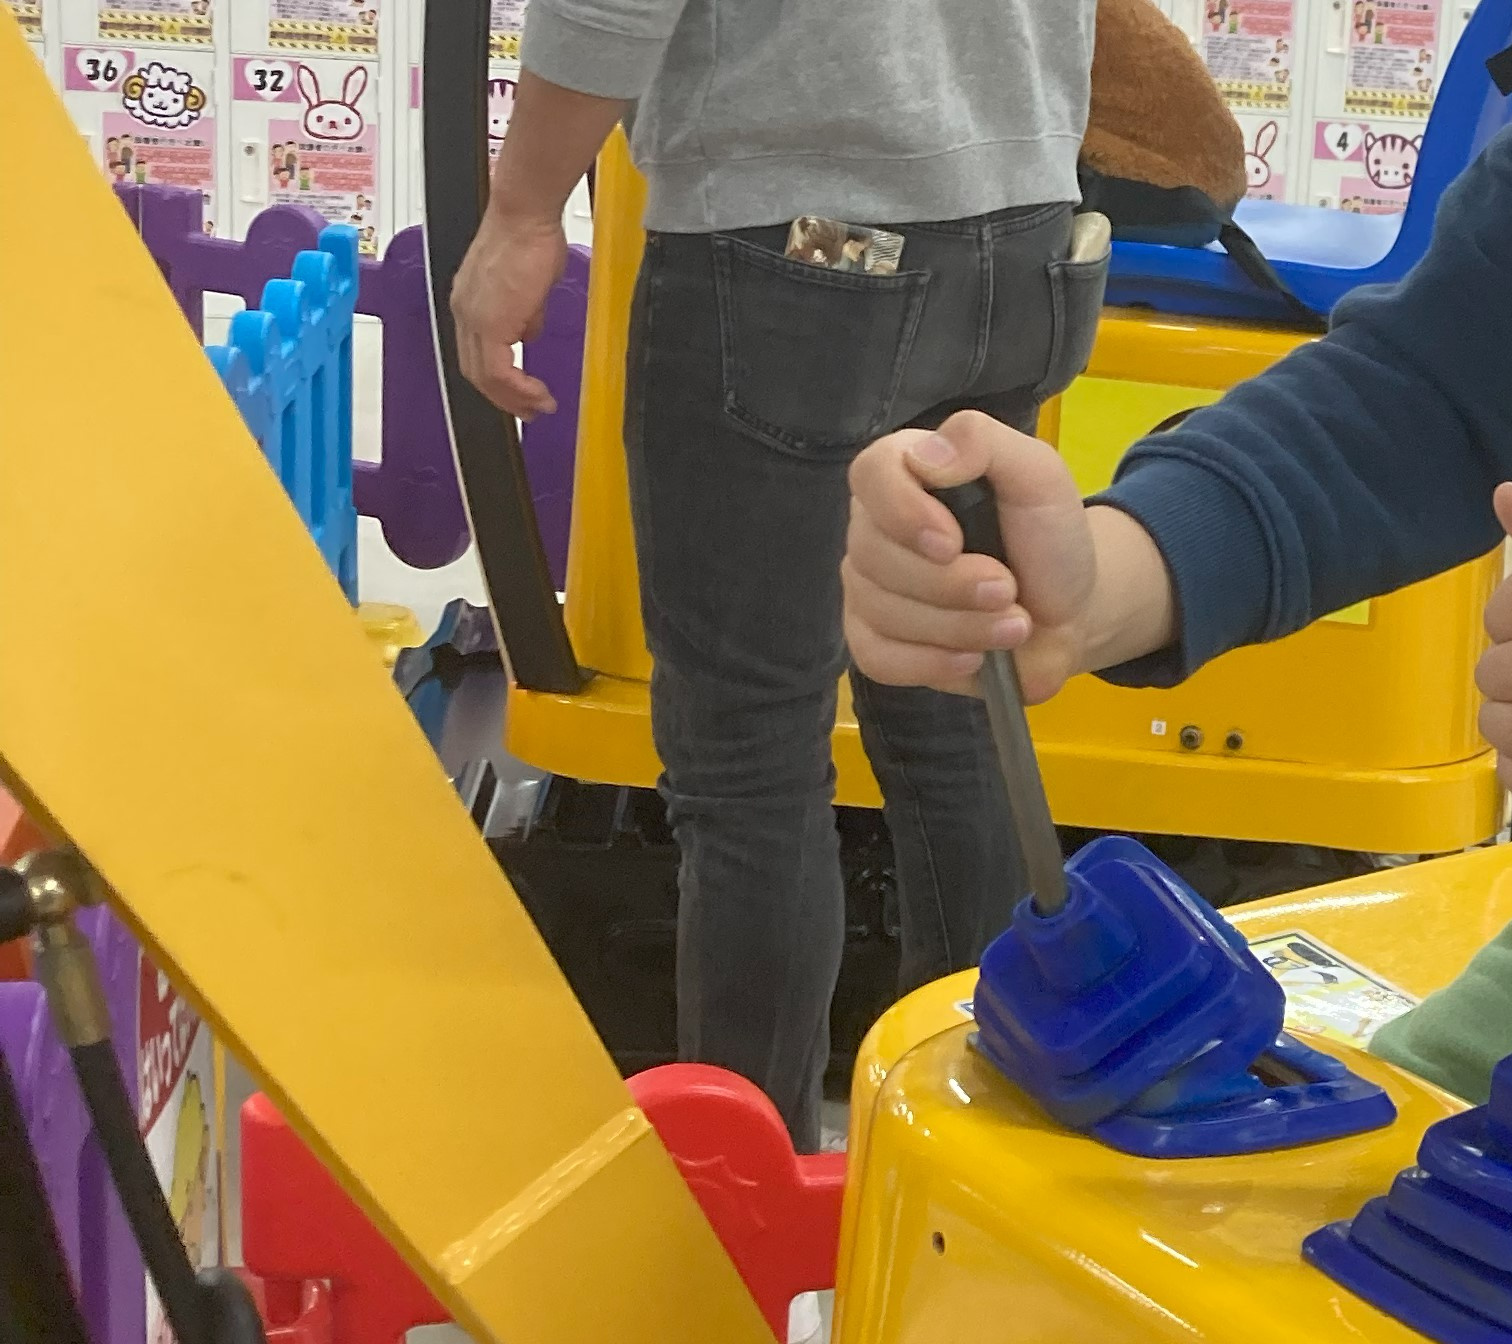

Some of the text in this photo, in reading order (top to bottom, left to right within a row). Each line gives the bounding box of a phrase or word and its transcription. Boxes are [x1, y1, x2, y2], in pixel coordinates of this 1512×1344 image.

[86, 58, 118, 82] 36
[253, 69, 284, 92] 32
[1335, 131, 1350, 152] 4
